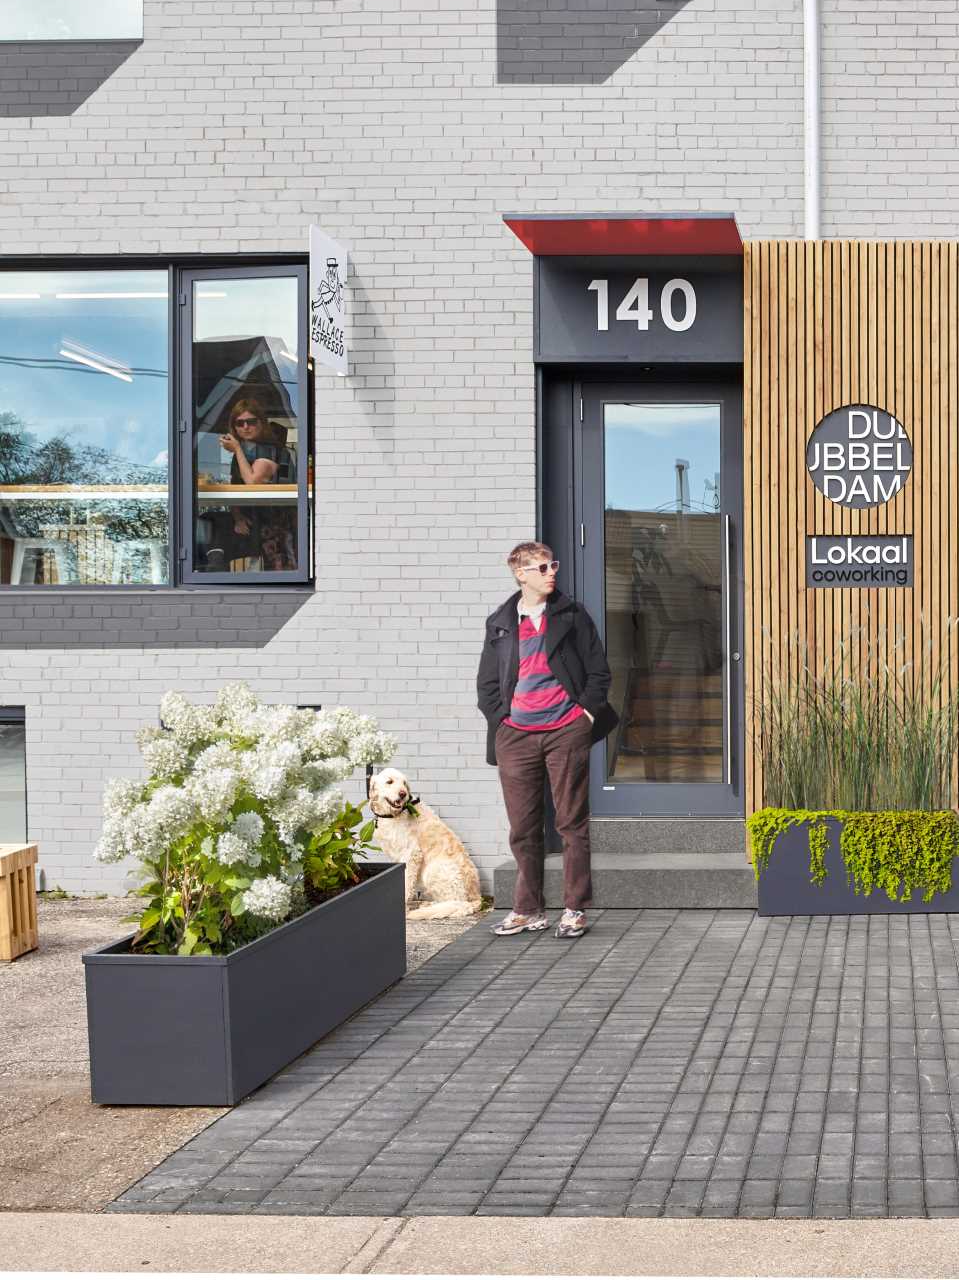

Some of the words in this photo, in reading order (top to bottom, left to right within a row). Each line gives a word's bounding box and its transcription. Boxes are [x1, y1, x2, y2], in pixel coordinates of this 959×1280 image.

[587, 278, 698, 332] 140
[311, 314, 344, 343] WALLACE
[311, 328, 344, 357] ESPRESSO
[848, 411, 907, 440] DU
[823, 474, 901, 503] DAM
[811, 537, 908, 564] Lokaal
[812, 566, 908, 585] coworking
